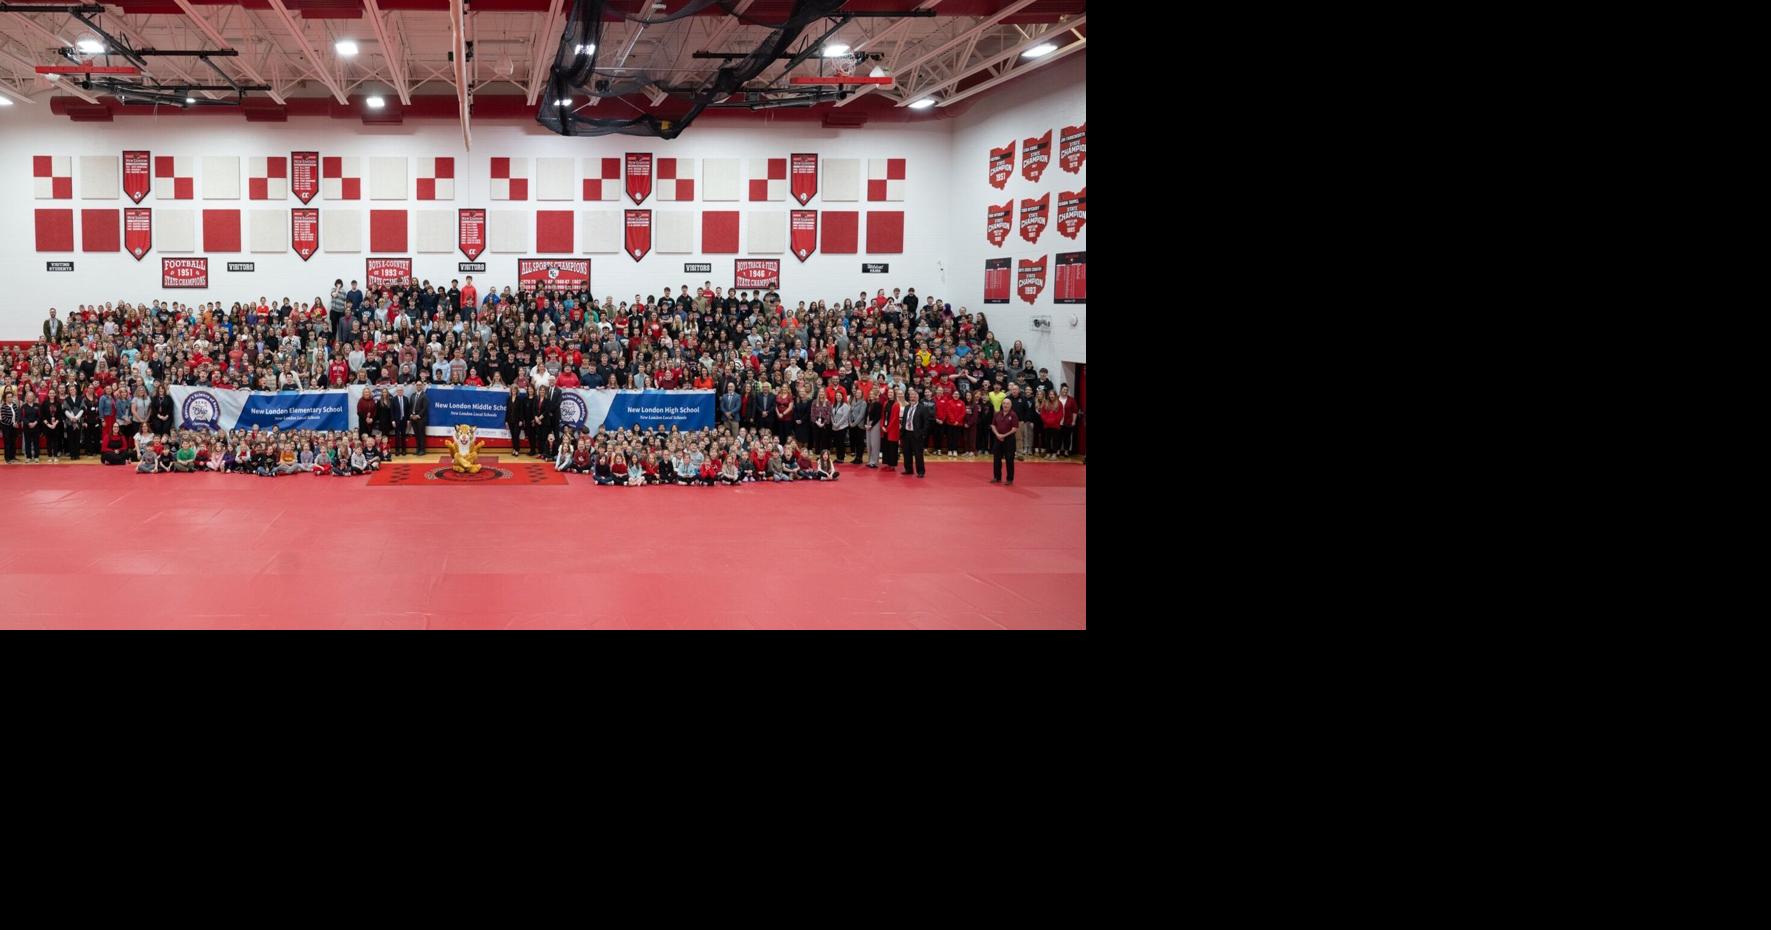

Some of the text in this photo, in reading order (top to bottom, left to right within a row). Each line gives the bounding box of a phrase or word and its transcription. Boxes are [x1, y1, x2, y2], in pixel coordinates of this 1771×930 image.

[1061, 144, 1086, 159] CHAMPIO
[1023, 155, 1048, 168] CHAMPION
[164, 260, 206, 270] FOOTBALL
[522, 261, 587, 275] ALL SPORTS CHAMPIONS
[1019, 278, 1043, 288] CHAMPION
[289, 406, 322, 415] Elementary
